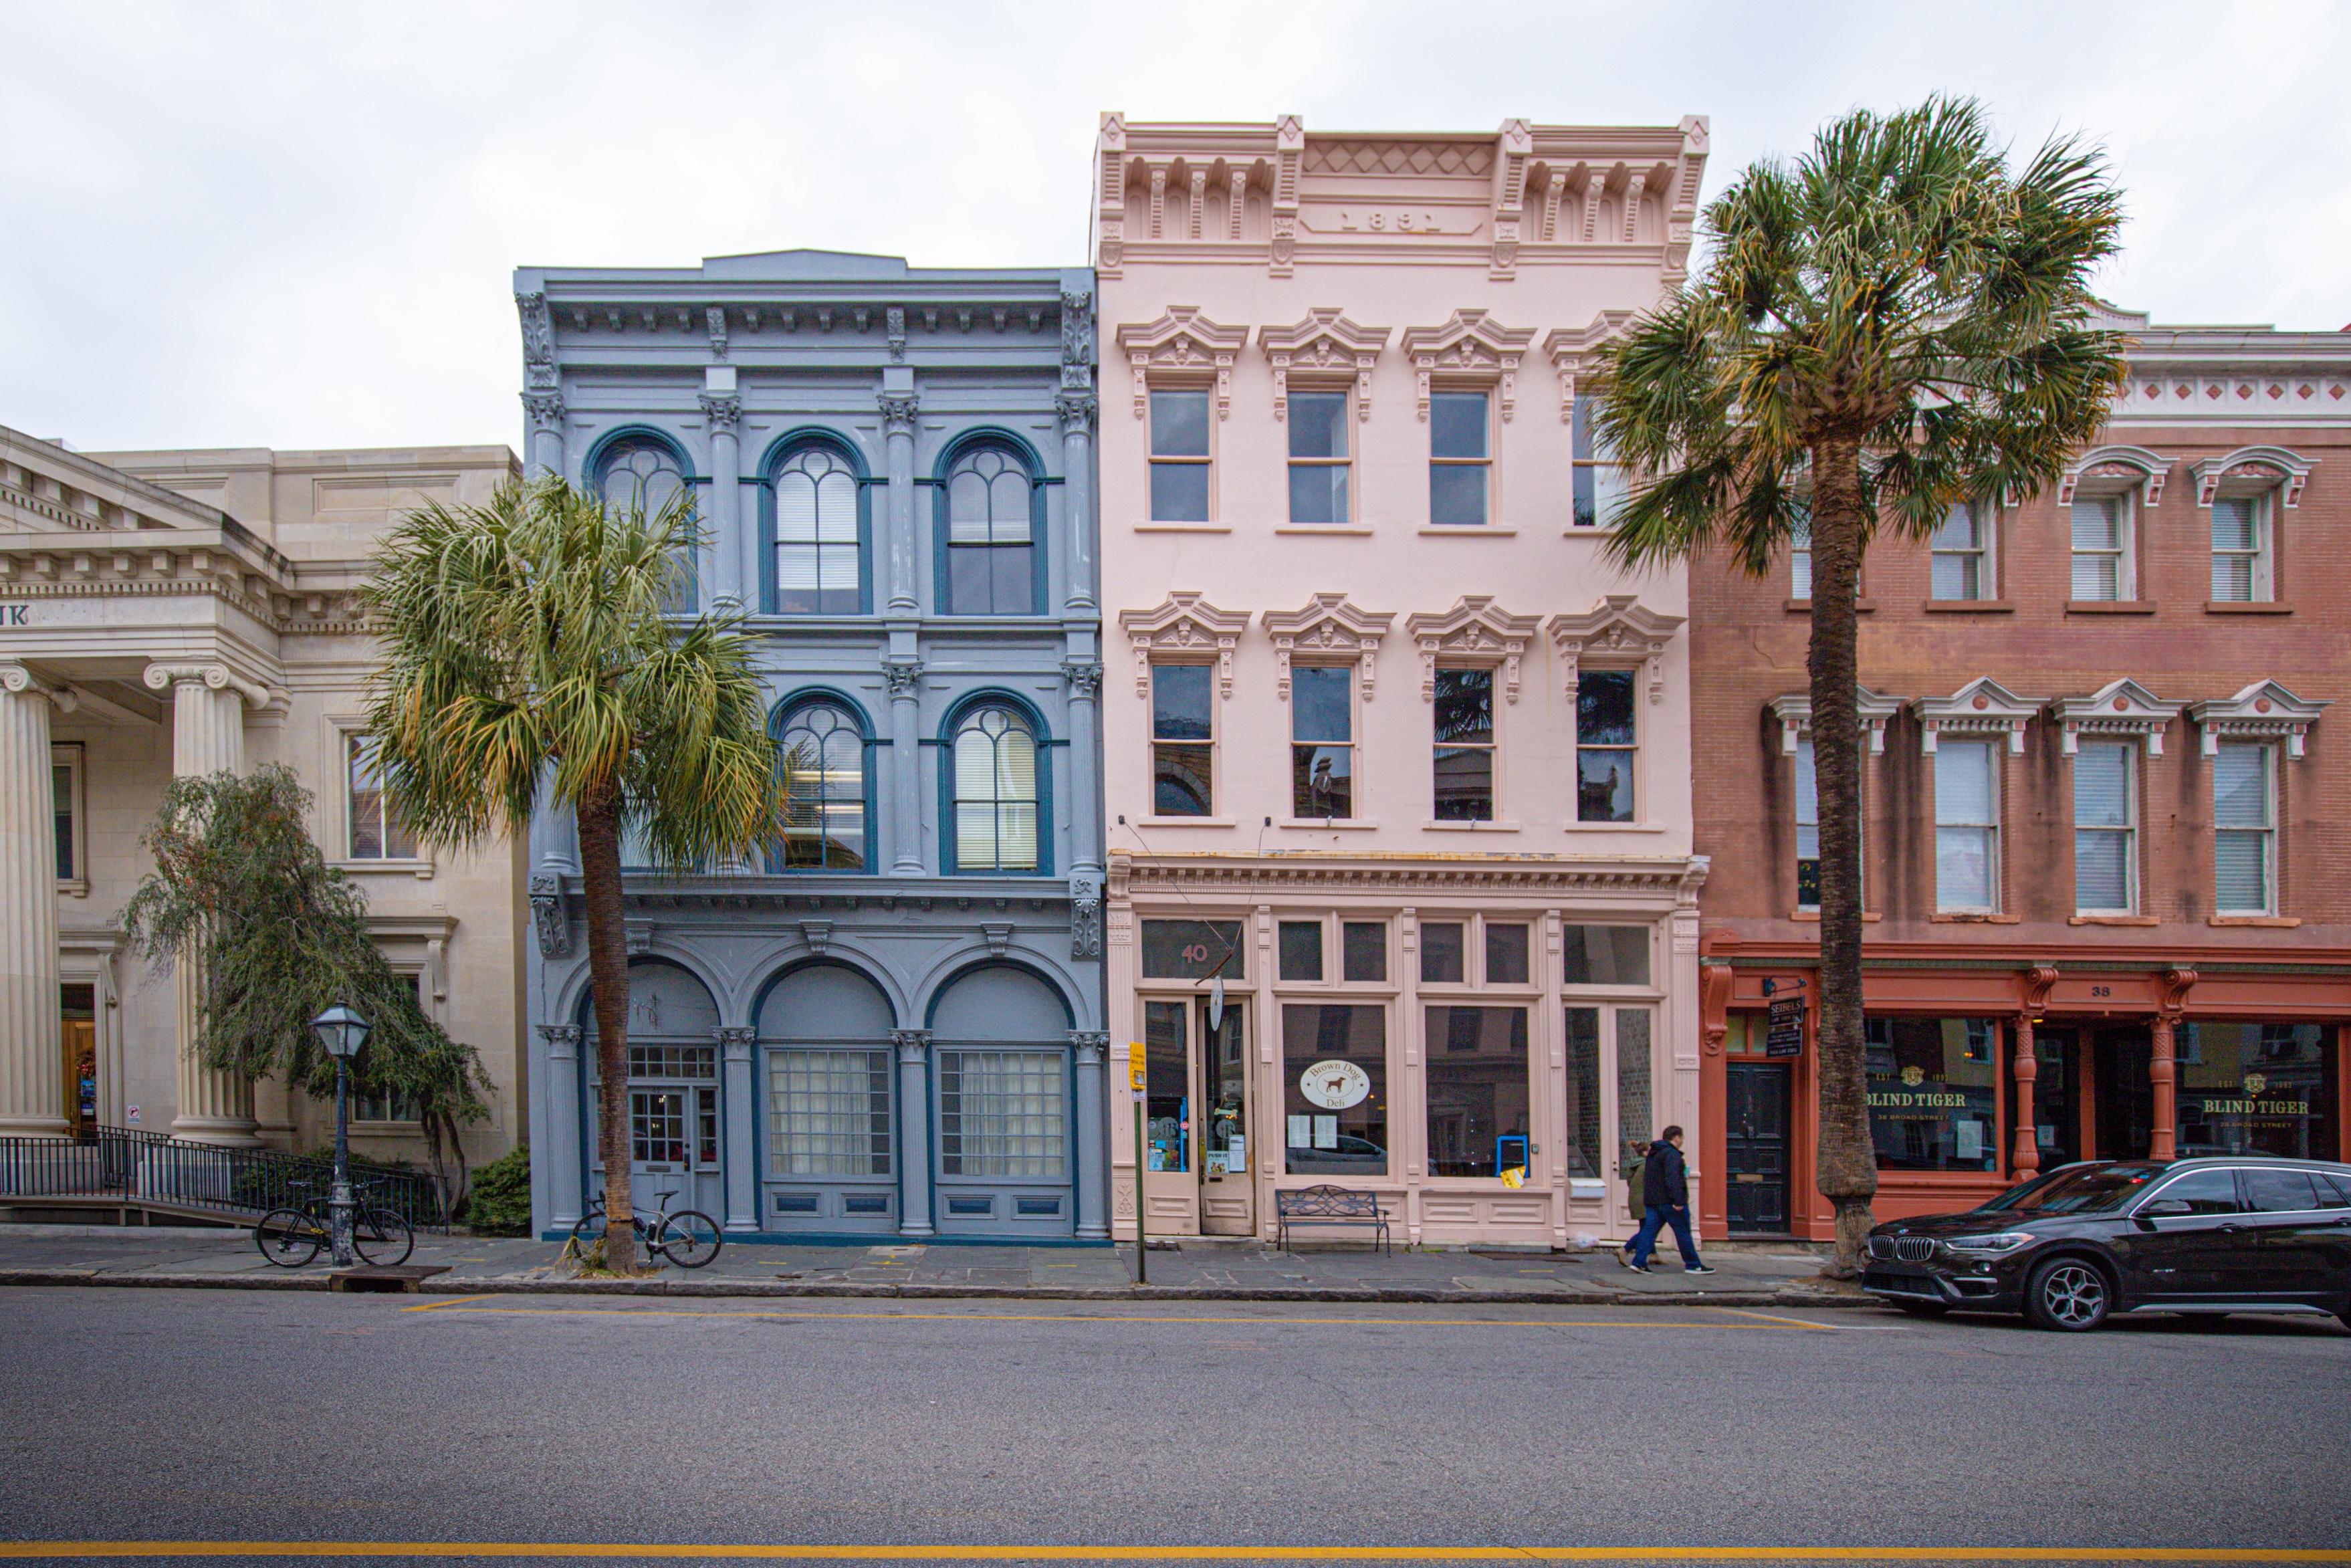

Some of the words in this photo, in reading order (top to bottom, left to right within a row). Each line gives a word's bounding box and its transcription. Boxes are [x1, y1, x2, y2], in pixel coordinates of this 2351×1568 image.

[1341, 211, 1441, 231] 1891
[1182, 945, 1208, 964] 40
[2091, 986, 2110, 997] 38
[1771, 1000, 1801, 1014] SEIBELS
[1309, 1063, 1341, 1077] Brown
[1343, 1063, 1361, 1081] Dog
[1327, 1099, 1345, 1107] Deli
[1915, 1093, 1967, 1107] TIGER
[2203, 1099, 2255, 1113] BLIND
[2257, 1100, 2310, 1115] TIGER
